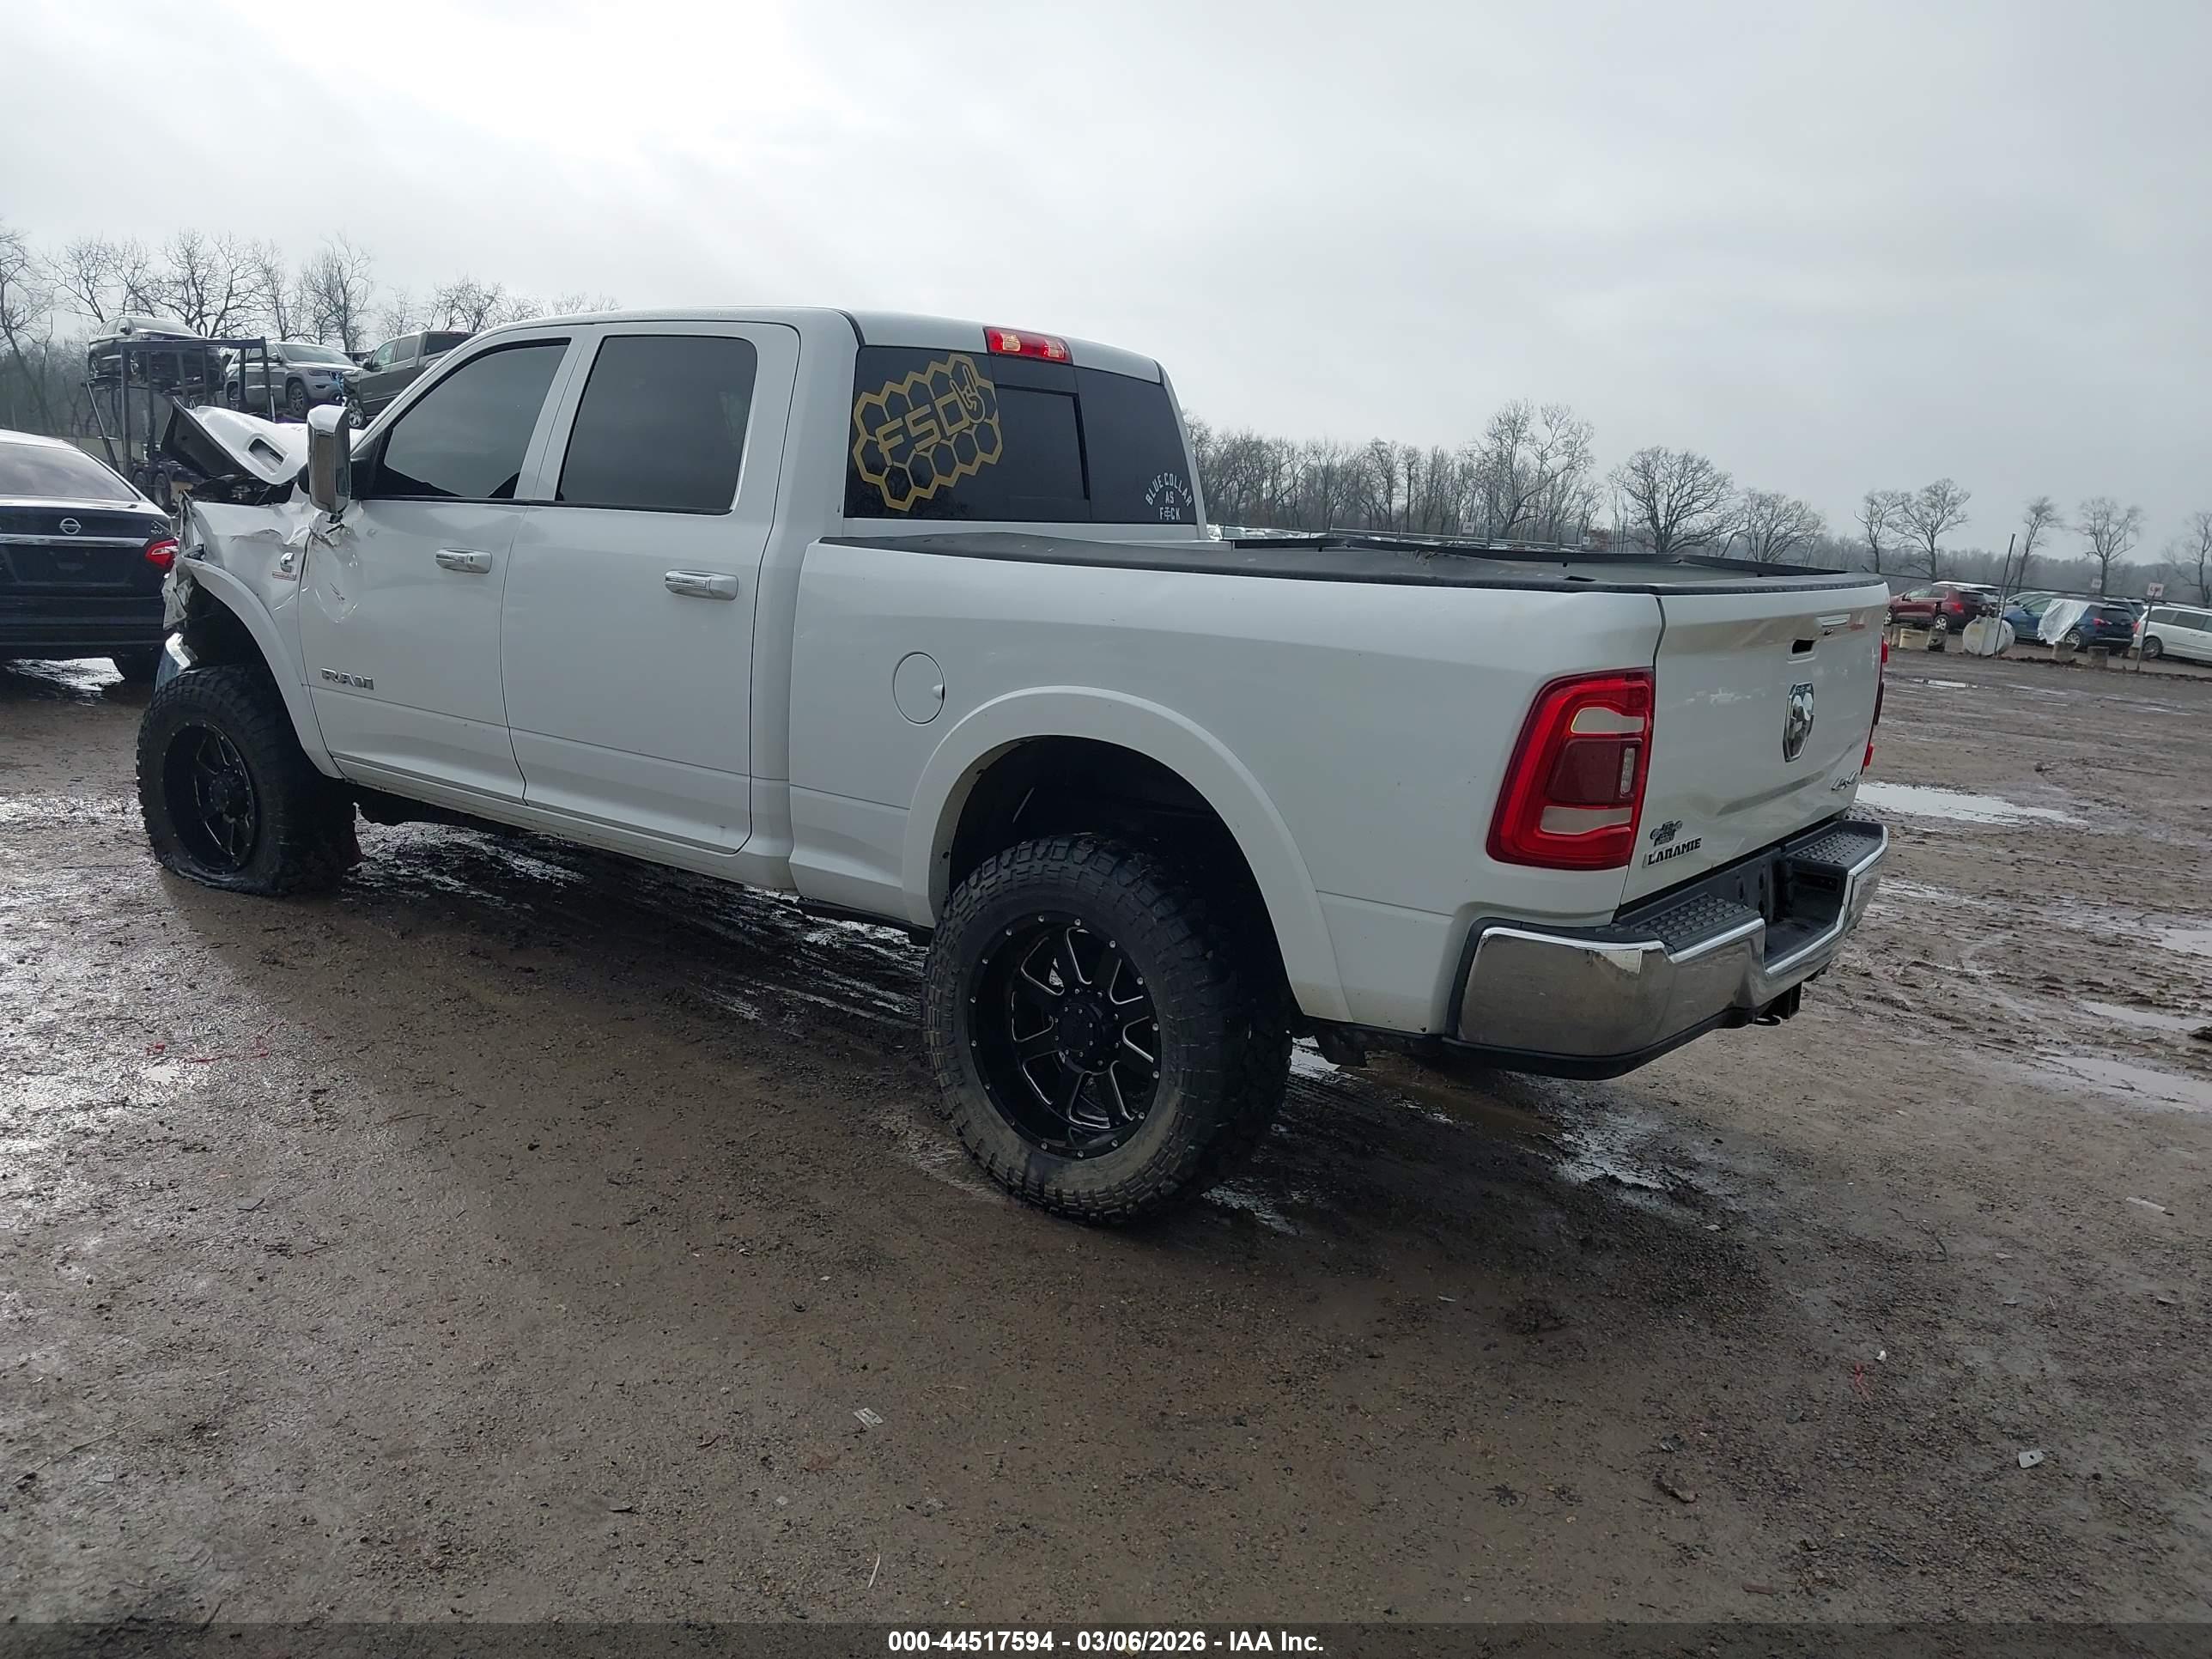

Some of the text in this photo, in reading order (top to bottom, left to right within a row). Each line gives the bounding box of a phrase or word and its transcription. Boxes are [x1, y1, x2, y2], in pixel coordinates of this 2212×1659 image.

[1145, 472, 1193, 507] BLUE COLLAR
[1165, 490, 1175, 504] AS
[320, 667, 374, 690] RAM
[1648, 837, 1702, 866] LARAMIE
